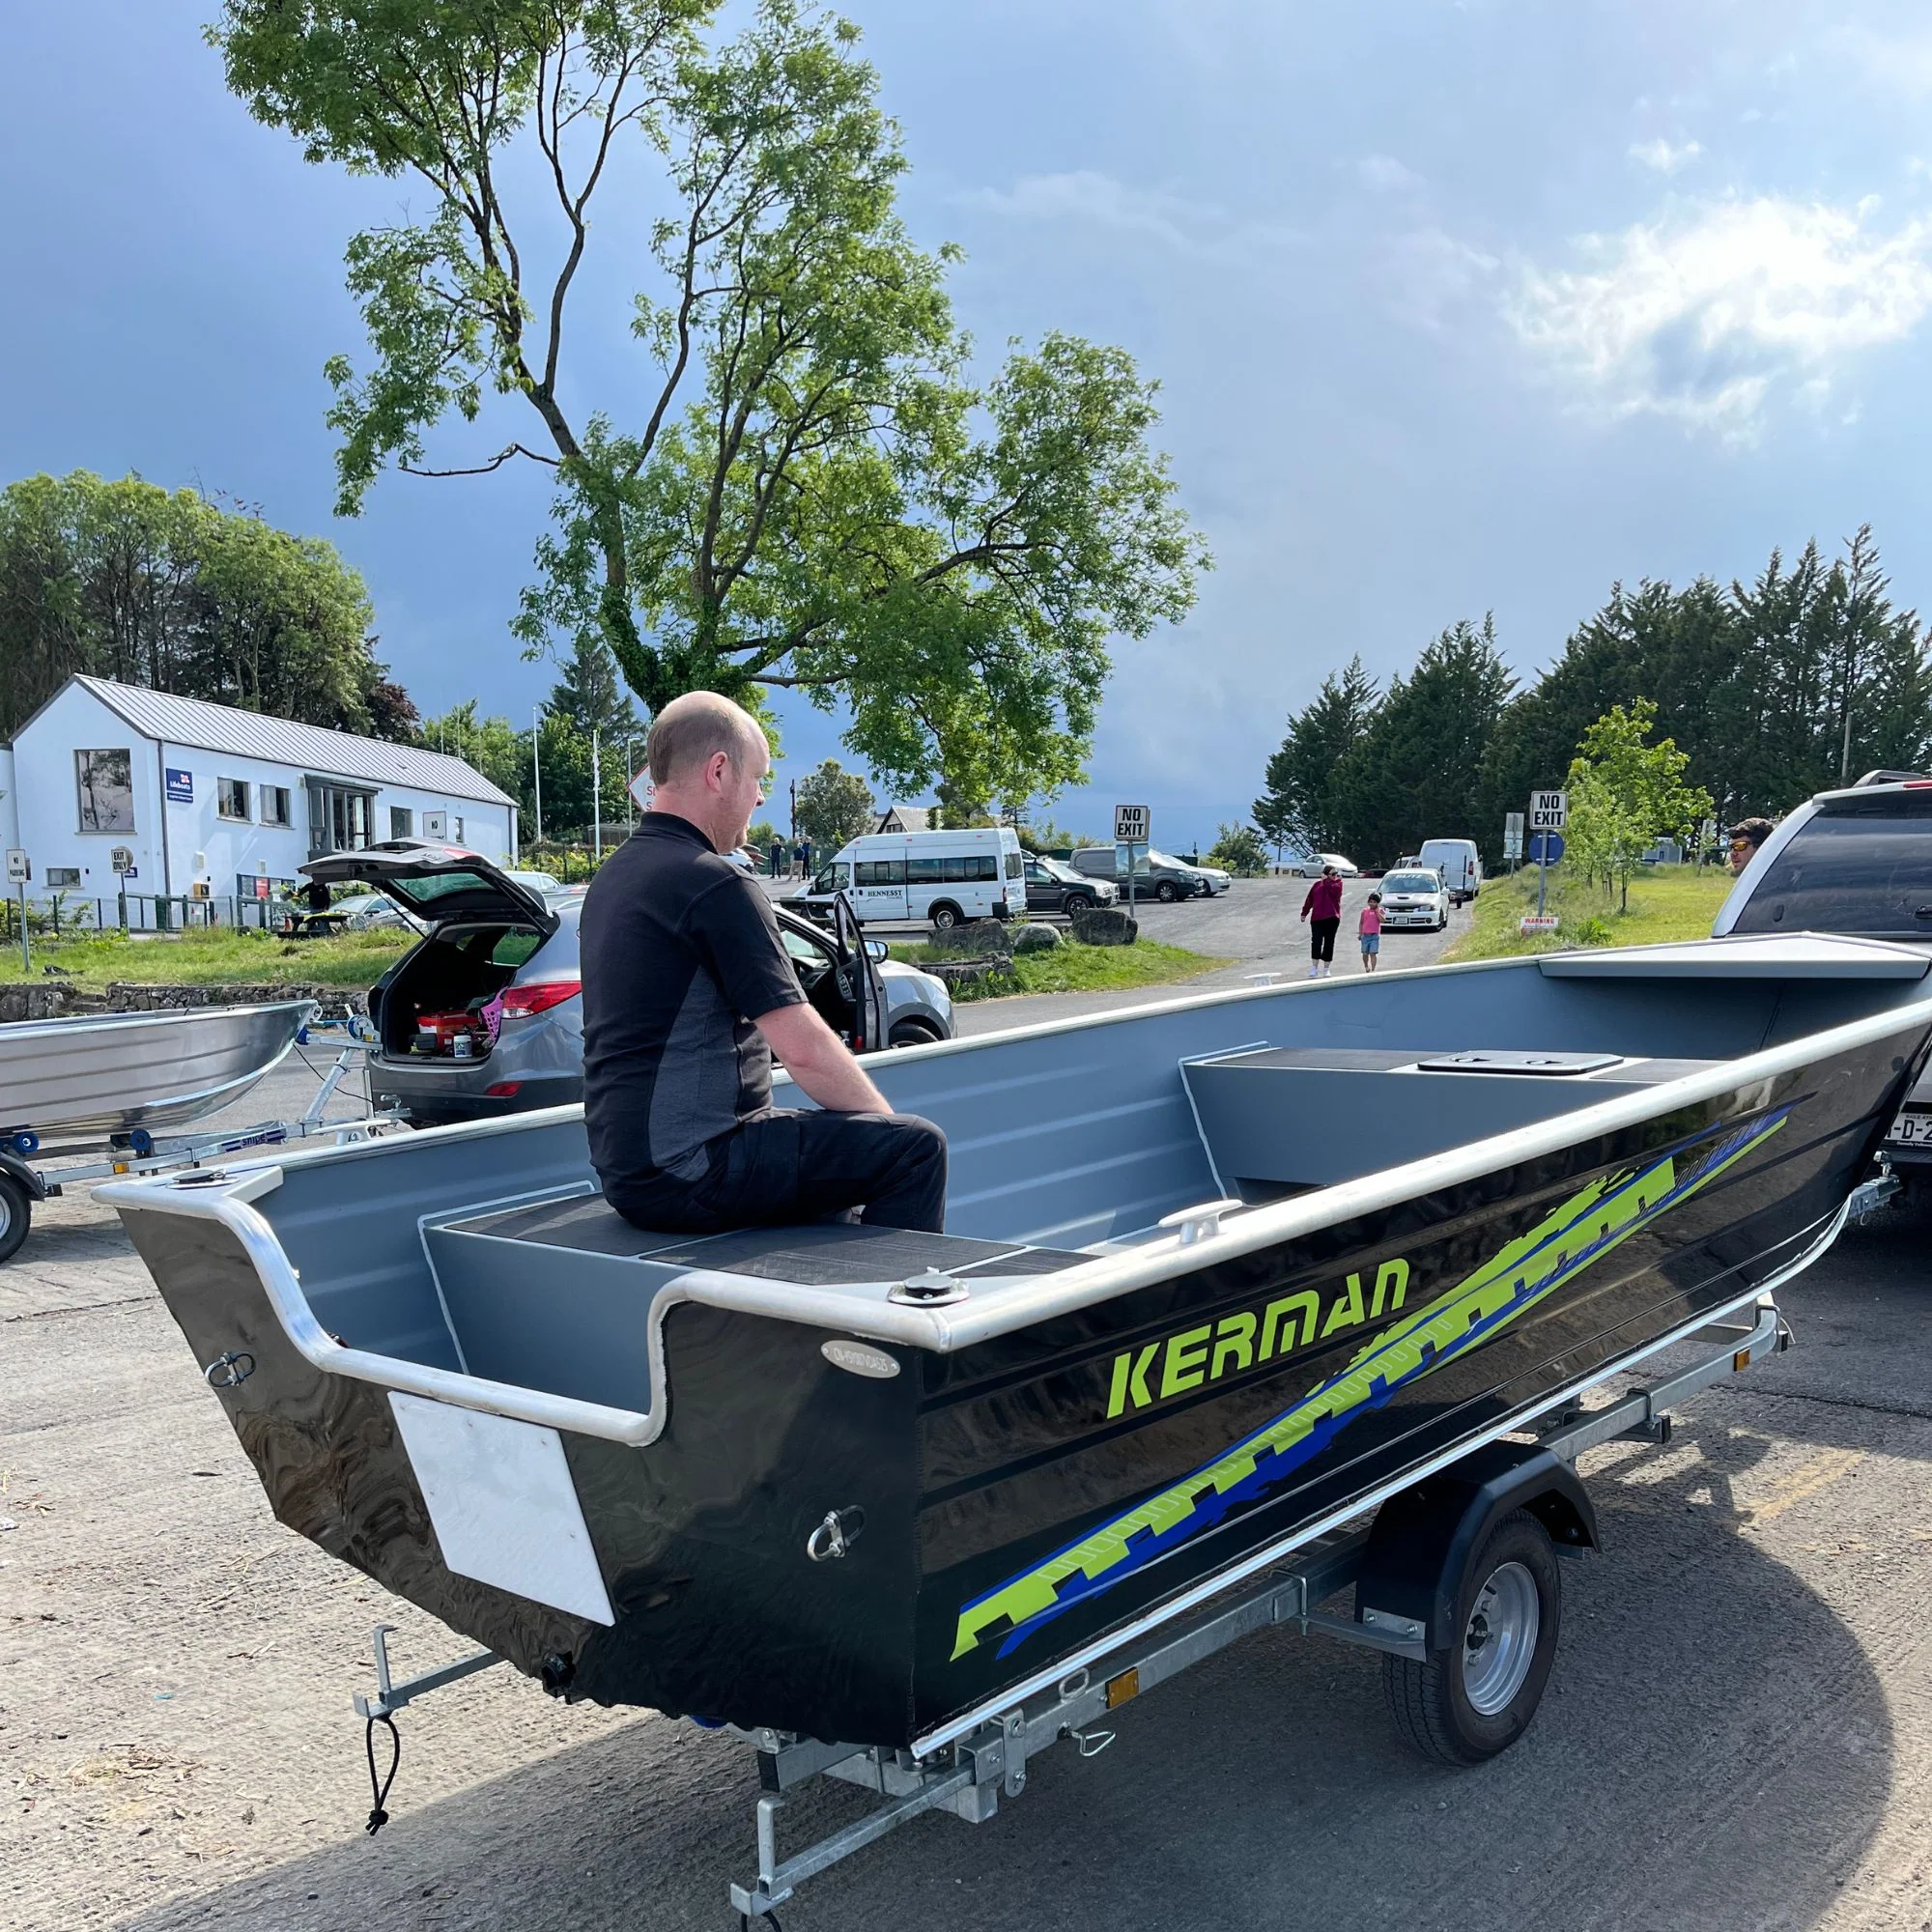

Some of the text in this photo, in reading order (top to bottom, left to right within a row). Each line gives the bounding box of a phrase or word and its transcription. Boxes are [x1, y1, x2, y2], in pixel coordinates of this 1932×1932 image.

[1539, 795, 1560, 810] NO
[1122, 809, 1141, 821] NO
[1534, 811, 1563, 825] EXIT
[431, 820, 439, 830] NO
[1118, 823, 1144, 836] EXIT
[113, 851, 125, 861] EXIT
[113, 861, 127, 870] ONLY
[1106, 1258, 1409, 1420] KERMAN
